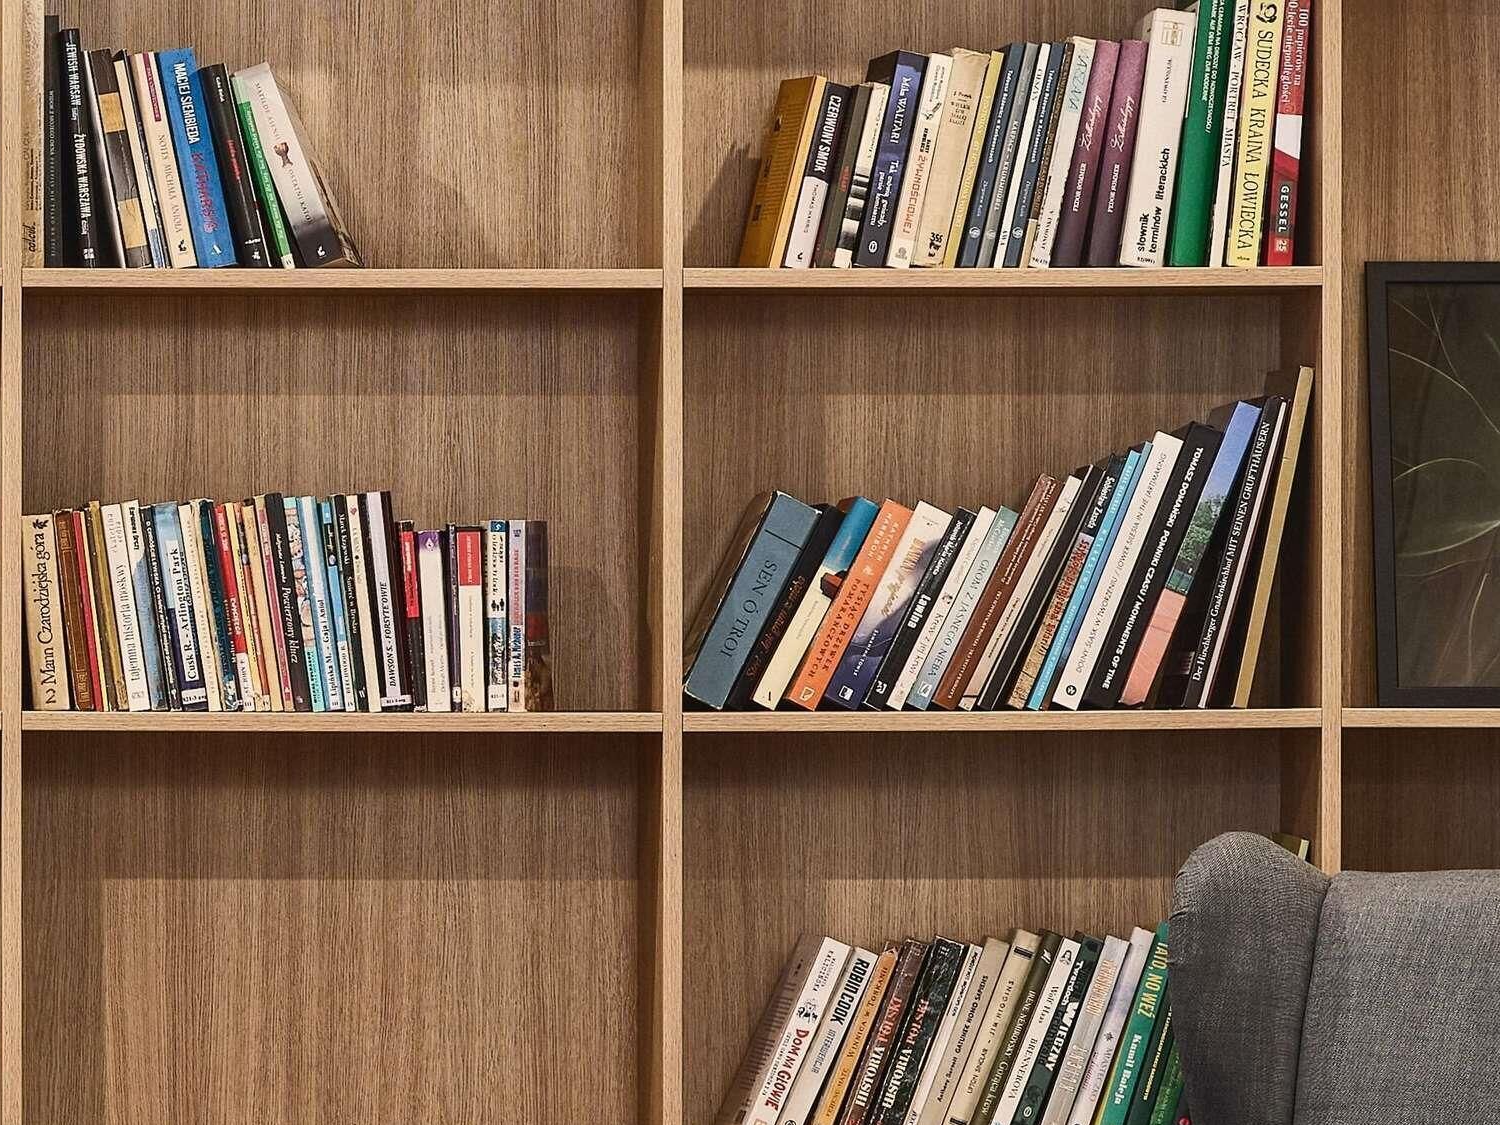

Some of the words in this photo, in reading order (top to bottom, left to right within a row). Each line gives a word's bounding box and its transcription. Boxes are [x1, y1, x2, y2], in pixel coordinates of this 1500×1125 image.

[1297, 7, 1309, 26] 100
[64, 41, 78, 71] JEWISH
[1251, 30, 1273, 99] SUDECKA
[1290, 27, 1308, 71] papierów
[67, 72, 81, 106] WARSAW
[172, 62, 190, 94] MACIEJ
[1225, 71, 1240, 118] PORTRET
[177, 94, 201, 144] SIEMBIEDA
[820, 94, 842, 144] CZERWONY
[889, 96, 907, 143] WALTARI
[1244, 107, 1266, 164] KRAINA
[72, 133, 89, 175] ŻYDOWSKA
[813, 143, 831, 172] SMOK
[1220, 127, 1234, 166] MIASTA
[888, 159, 899, 173] Tak
[1152, 147, 1172, 200] literackich
[76, 175, 91, 217] WARSZAWA
[1236, 172, 1259, 250] ŁOWIECKA
[1278, 185, 1289, 232] GESSEL
[1134, 212, 1151, 252] słownik
[1146, 205, 1164, 253] terminów
[1183, 445, 1204, 481] TOMASZ
[1164, 480, 1191, 528] DOMAŃSKI
[1231, 500, 1250, 537] SEINEN
[30, 532, 50, 561] góra
[168, 547, 181, 574] Park
[1148, 528, 1170, 566] POMNIKI
[1225, 537, 1239, 556] MIT
[114, 564, 128, 600] moskwy
[750, 559, 778, 596] SEN
[1137, 565, 1155, 595] CZASU
[31, 562, 55, 645] Czarodziejska
[119, 603, 134, 640] historia
[173, 578, 191, 630] Arlington
[906, 593, 932, 630] Lawina
[280, 587, 295, 638] Powierzony
[288, 638, 299, 663] klucz
[321, 625, 330, 642] Gaja
[719, 614, 749, 658] TROI
[941, 600, 970, 646] JASNEGO
[1113, 600, 1142, 654] MONUMENTS
[821, 621, 850, 672] DRZEWEK
[926, 647, 947, 678] NIEBA
[39, 648, 56, 685] Mann
[185, 654, 197, 679] Cusk
[386, 652, 397, 686] DAWSON
[1100, 667, 1116, 689] TIME
[1191, 665, 1204, 682] Der
[843, 958, 870, 994] ROBIN
[974, 973, 989, 1001] SAPIENS
[1044, 983, 1060, 1005] Wolf
[1058, 958, 1085, 1007] Twardoch
[1145, 972, 1163, 991] NO
[829, 991, 854, 1026] COOK
[787, 1026, 810, 1057] DOM
[854, 1043, 886, 1107] HISTORIA
[876, 994, 903, 1044] POLSKI
[881, 1046, 912, 1108] HISTORIA
[904, 997, 930, 1045] POLSKI
[782, 1055, 796, 1069] NA
[1006, 1037, 1038, 1100] BRENNEROVA
[979, 1092, 996, 1116] krew
